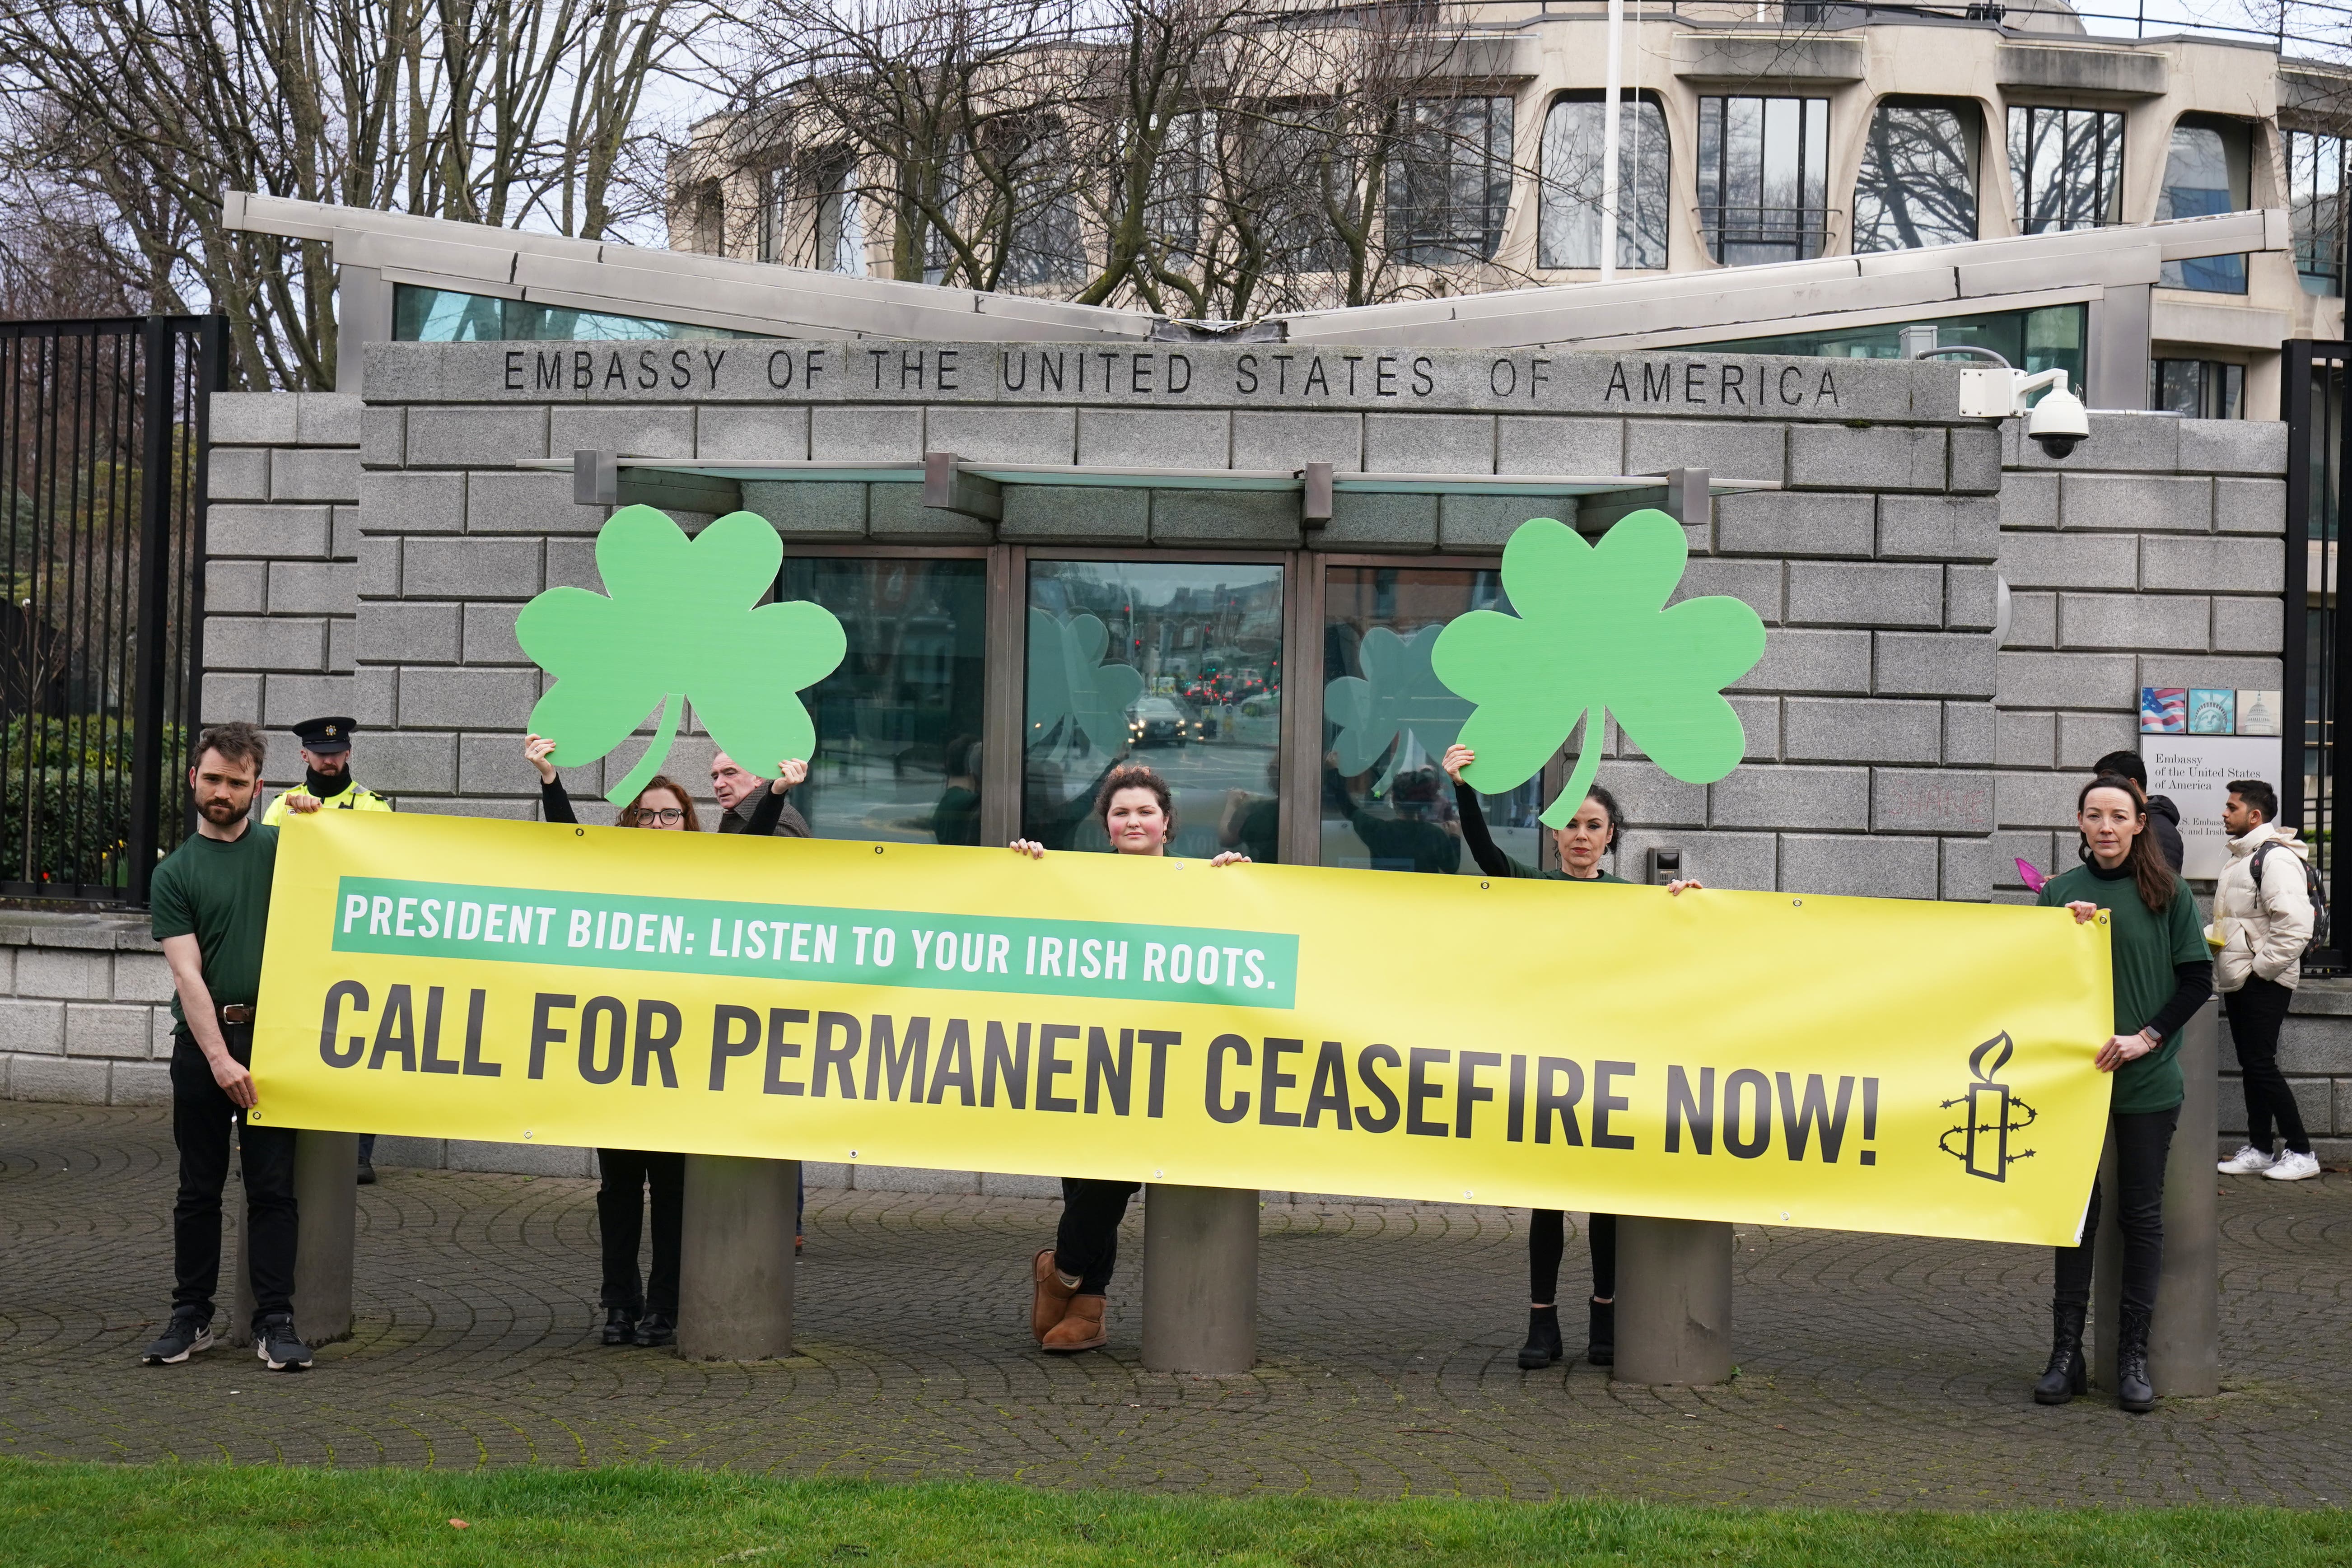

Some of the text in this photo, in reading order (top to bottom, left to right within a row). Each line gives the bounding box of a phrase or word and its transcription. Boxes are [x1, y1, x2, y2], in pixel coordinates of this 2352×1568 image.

[505, 350, 1841, 408] EMBASSY OF THE UNITED STATES OF AMERICA
[2155, 767, 2261, 778] of the United States
[2156, 753, 2203, 766] Embassy
[2155, 780, 2211, 790] of America
[342, 894, 1276, 990] PRESIDENT BIDEN: LISTEN TO YOUR IRISH ROOTS.
[319, 980, 1879, 1167] CALL FOR PERMANENT CEASEFIRE NOW!
